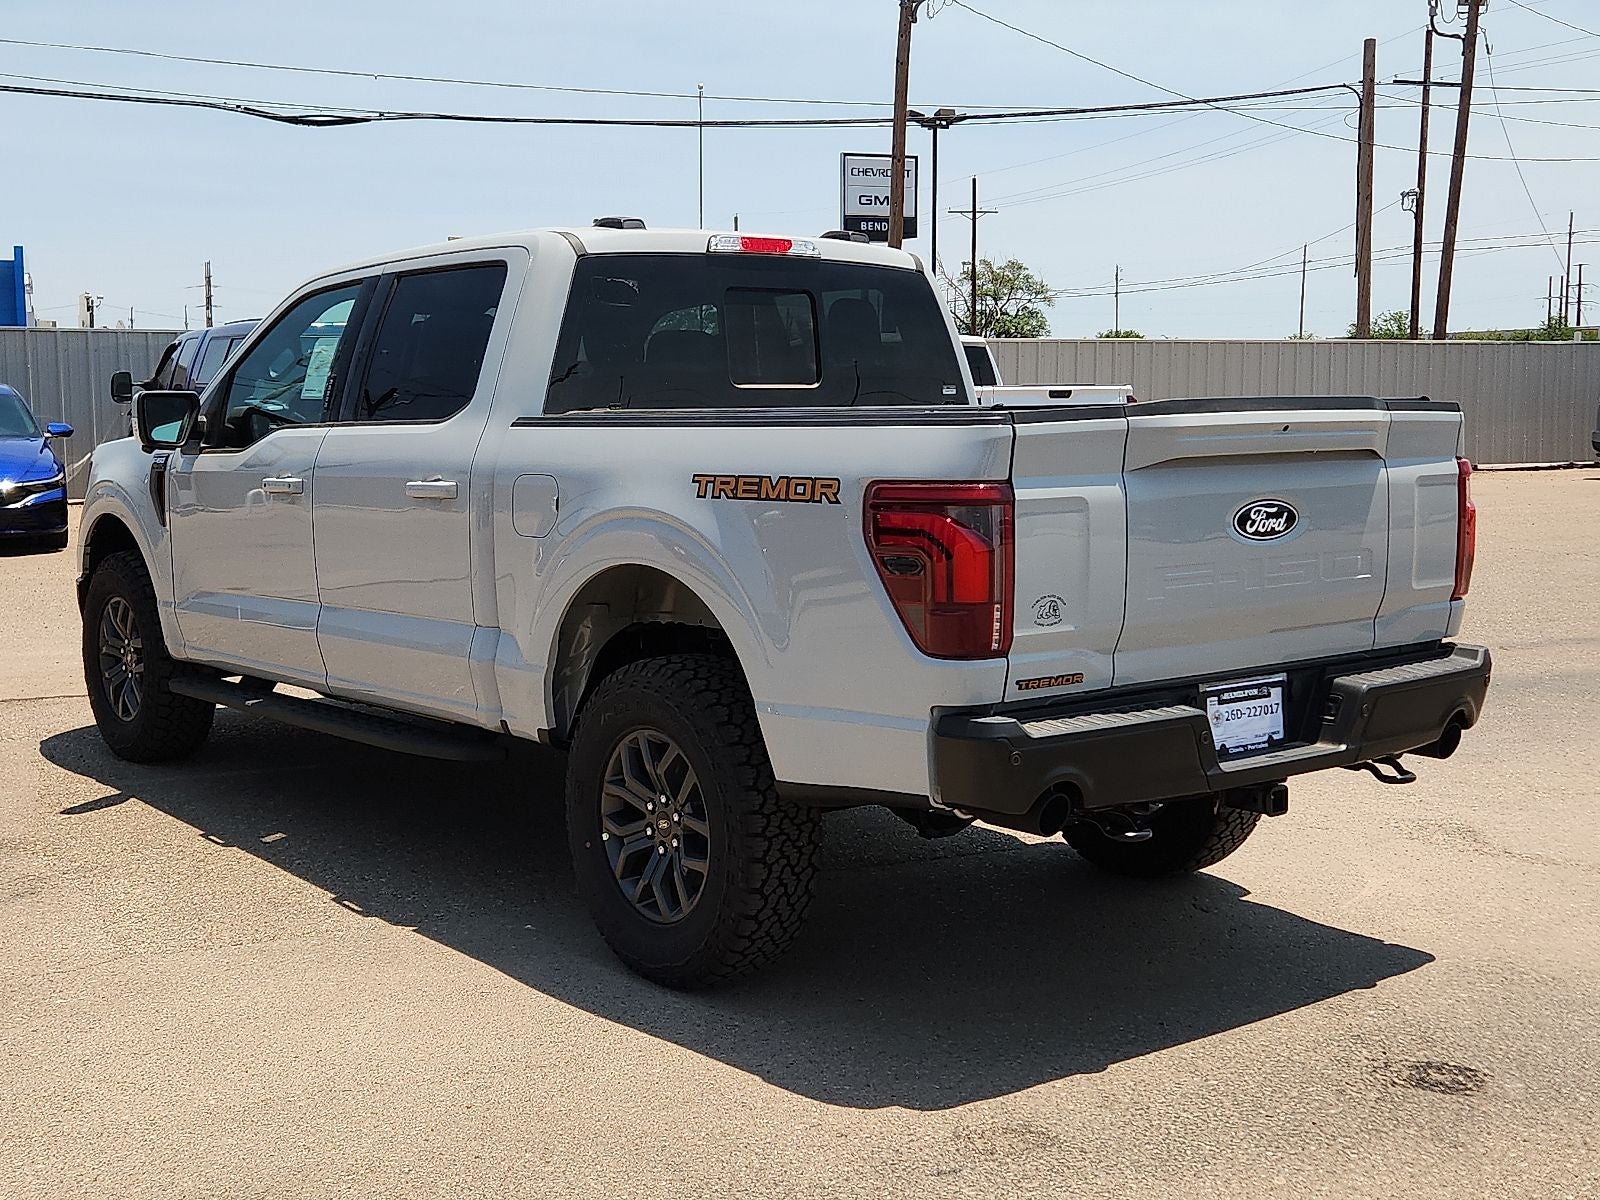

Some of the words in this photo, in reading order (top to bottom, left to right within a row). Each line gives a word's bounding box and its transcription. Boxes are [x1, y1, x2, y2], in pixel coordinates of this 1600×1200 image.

[850, 167, 911, 179] CHEVROT
[858, 194, 890, 207] GM
[860, 221, 889, 231] BEND
[692, 474, 841, 504] TREMOR
[1245, 506, 1287, 533] Ford
[1015, 673, 1083, 690] TREMOR
[1224, 702, 1280, 721] 26D-227017
